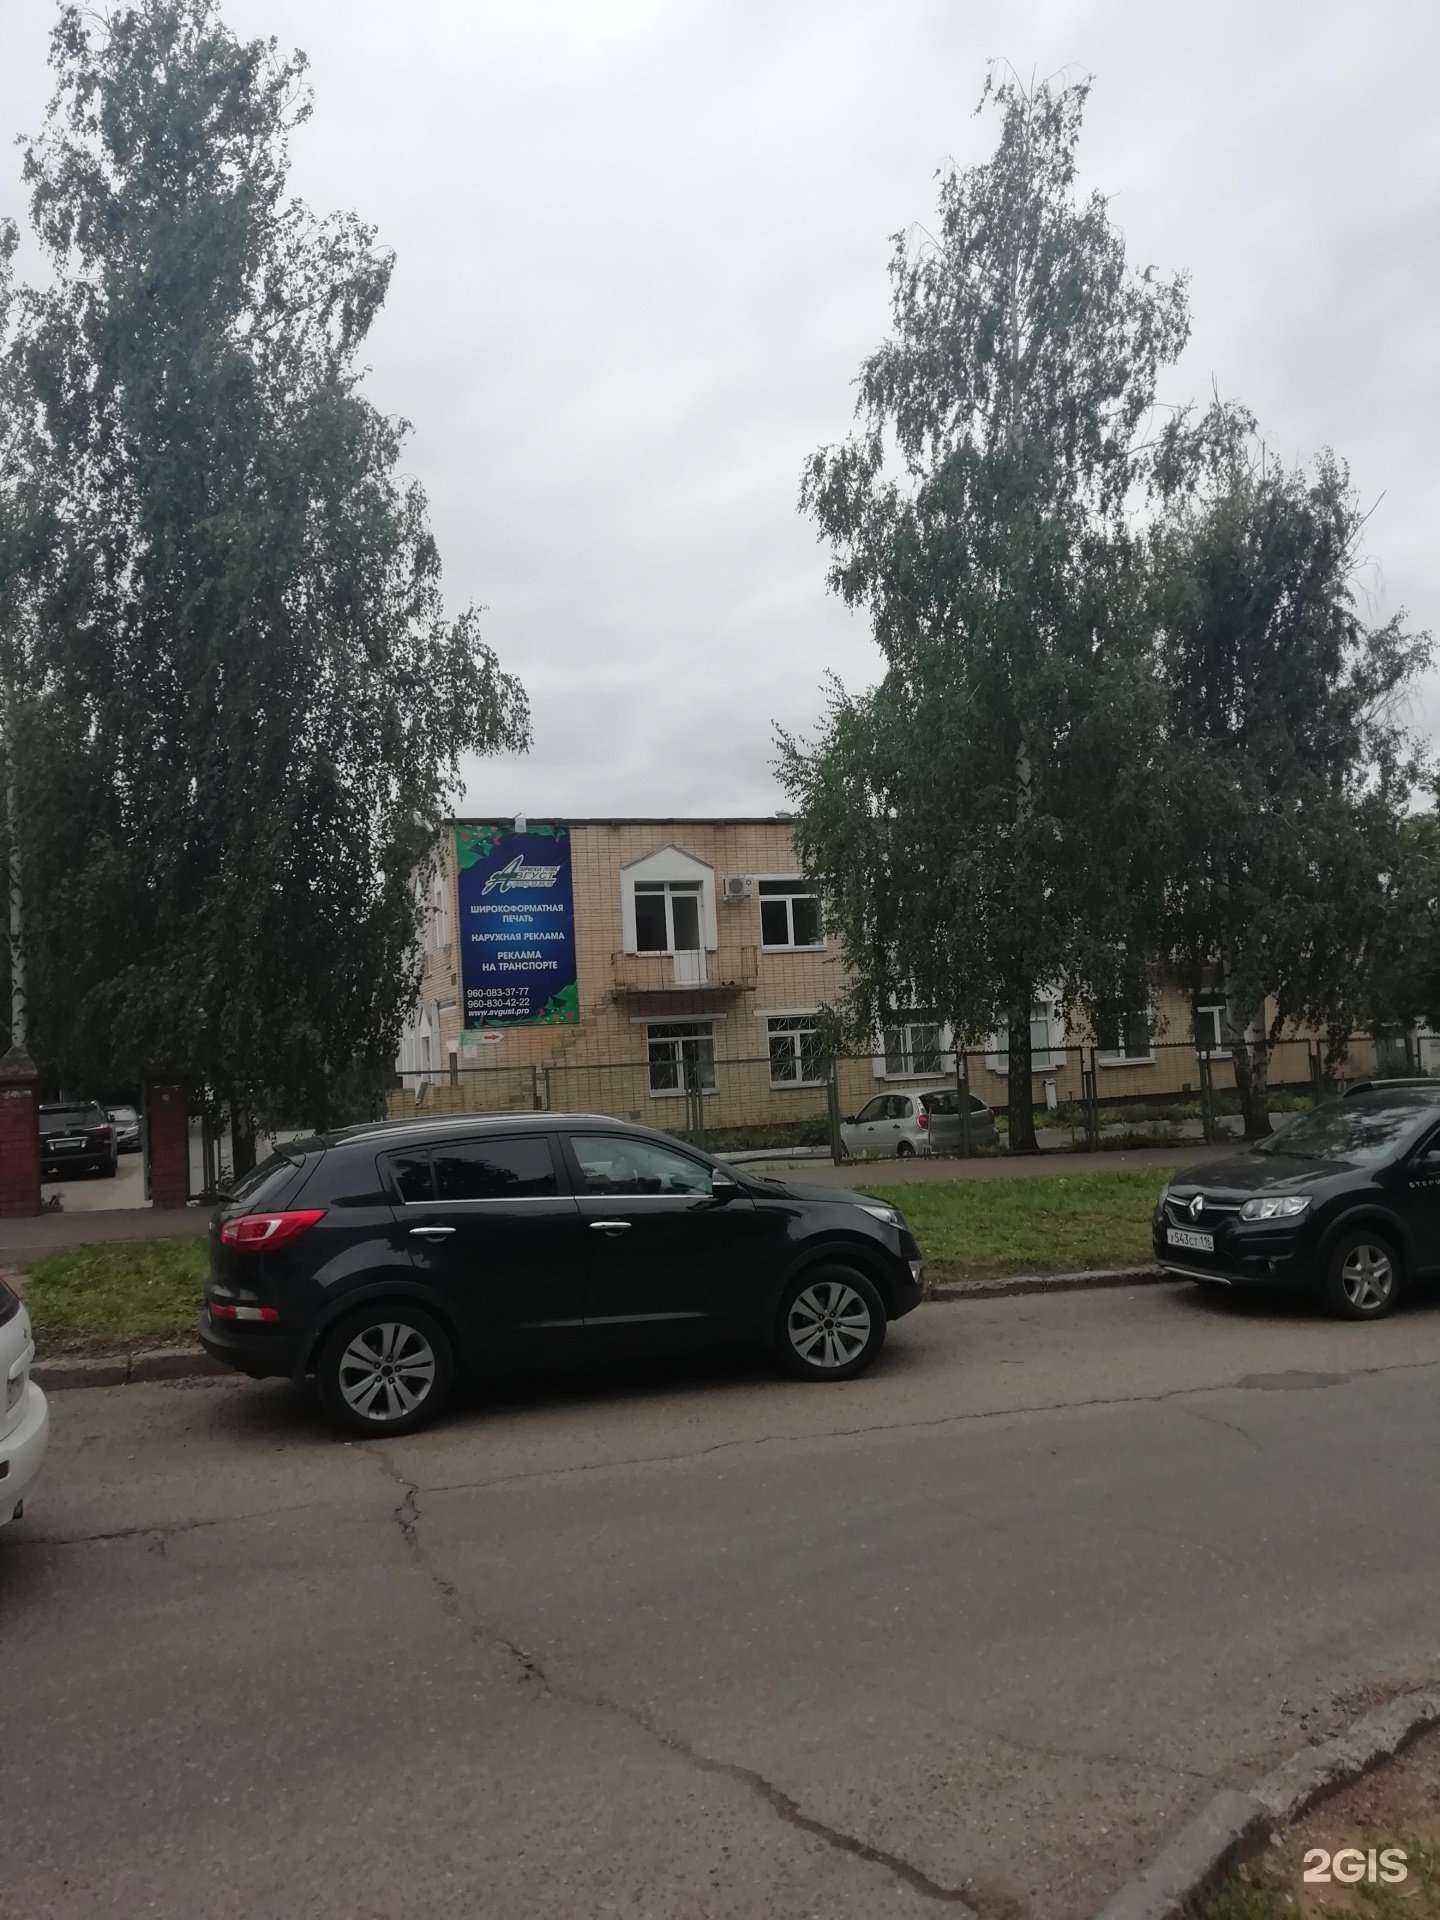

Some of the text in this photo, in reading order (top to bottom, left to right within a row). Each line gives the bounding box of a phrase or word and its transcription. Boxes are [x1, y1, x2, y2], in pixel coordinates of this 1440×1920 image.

[470, 904, 564, 913] ШИРОКОФОРМАТНАЯ
[502, 914, 533, 923] ПЕЧАТЬ
[471, 931, 565, 942] НАРУЖНАЯ РЕКЛАМА
[497, 950, 542, 960] РЕКЛАМА
[482, 961, 558, 971] НА ТРАНСПОРТЕ
[467, 987, 529, 998] 960-083-37-77
[467, 998, 530, 1008] 960-830-42-22
[468, 1007, 530, 1017] www.avgust.pro
